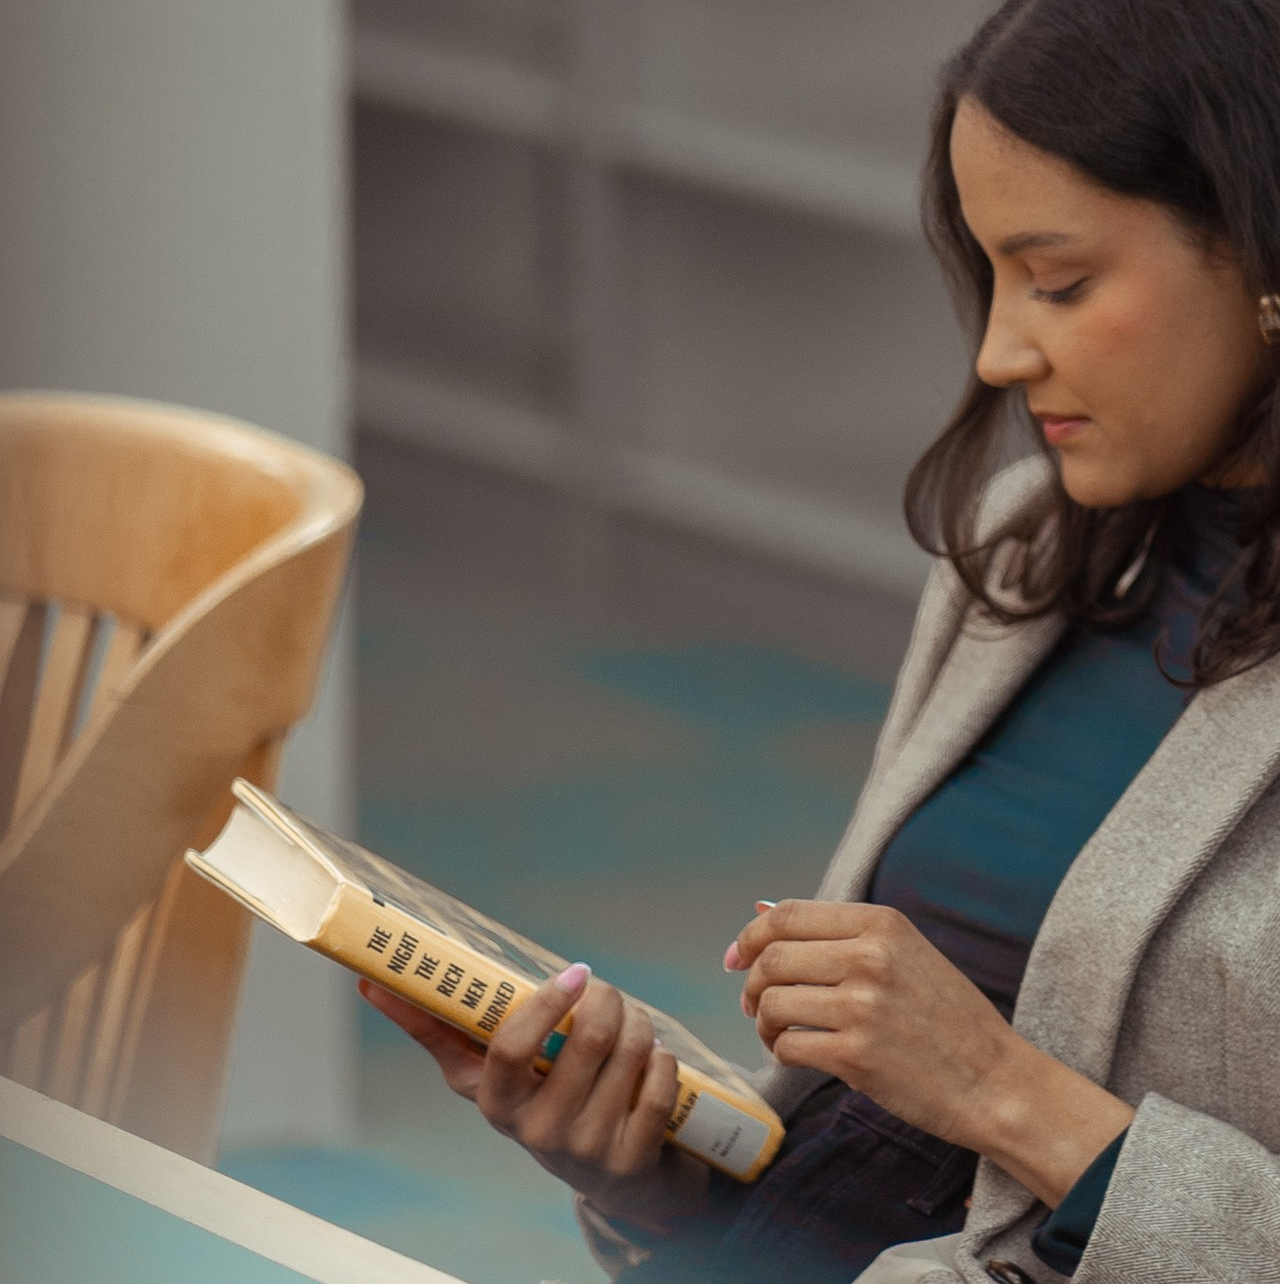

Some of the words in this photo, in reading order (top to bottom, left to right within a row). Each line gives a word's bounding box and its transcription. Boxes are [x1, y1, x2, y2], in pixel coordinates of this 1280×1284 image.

[366, 926, 393, 954] THE
[386, 931, 420, 975] NIGHT
[414, 953, 441, 980] THE
[436, 963, 466, 998] RICH
[461, 977, 489, 1011] MEN
[477, 981, 516, 1033] BURNED
